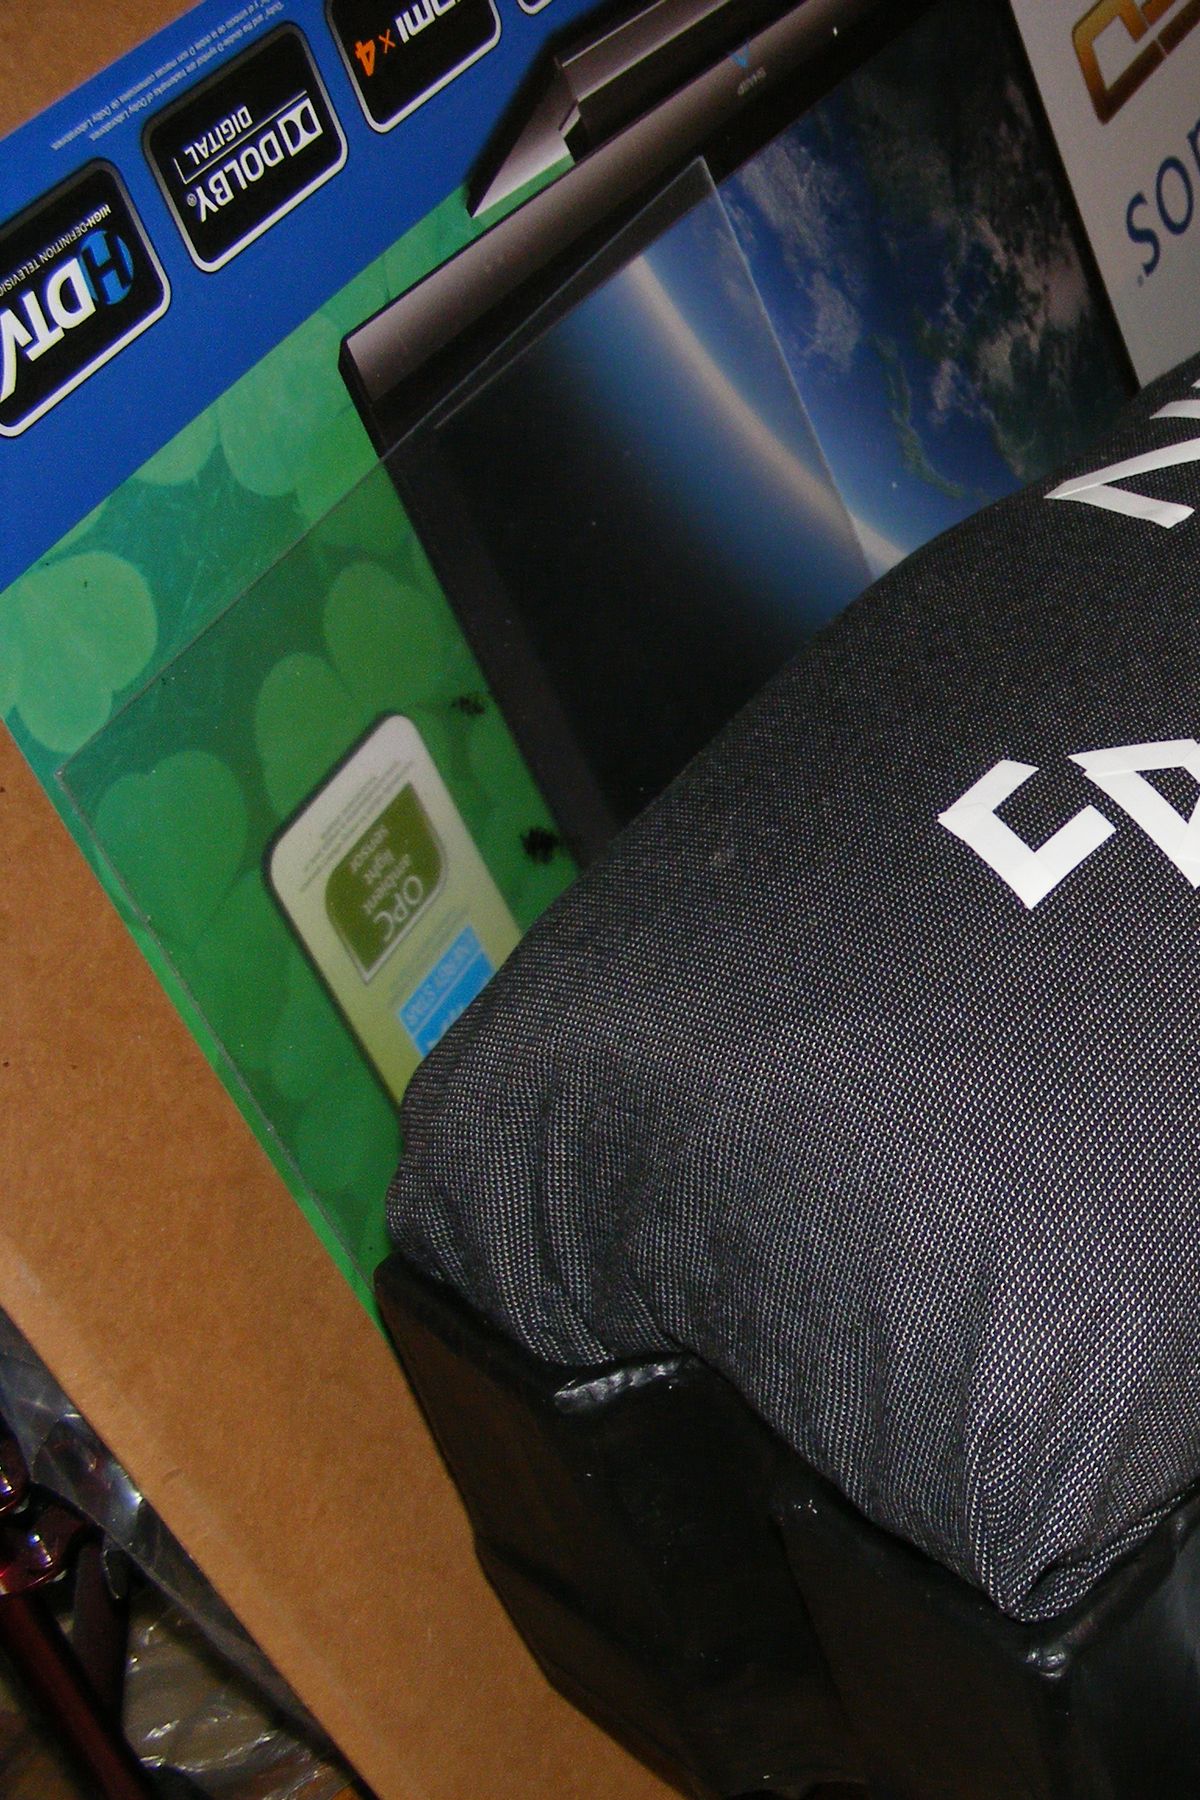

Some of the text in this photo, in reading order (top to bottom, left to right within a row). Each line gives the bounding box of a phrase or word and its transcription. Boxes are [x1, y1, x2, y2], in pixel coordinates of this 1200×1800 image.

[184, 106, 253, 165] DIGITAL
[38, 204, 111, 264] HIGH-DEFINITION
[0, 230, 134, 401] HDTV
[372, 876, 424, 941] OPC
